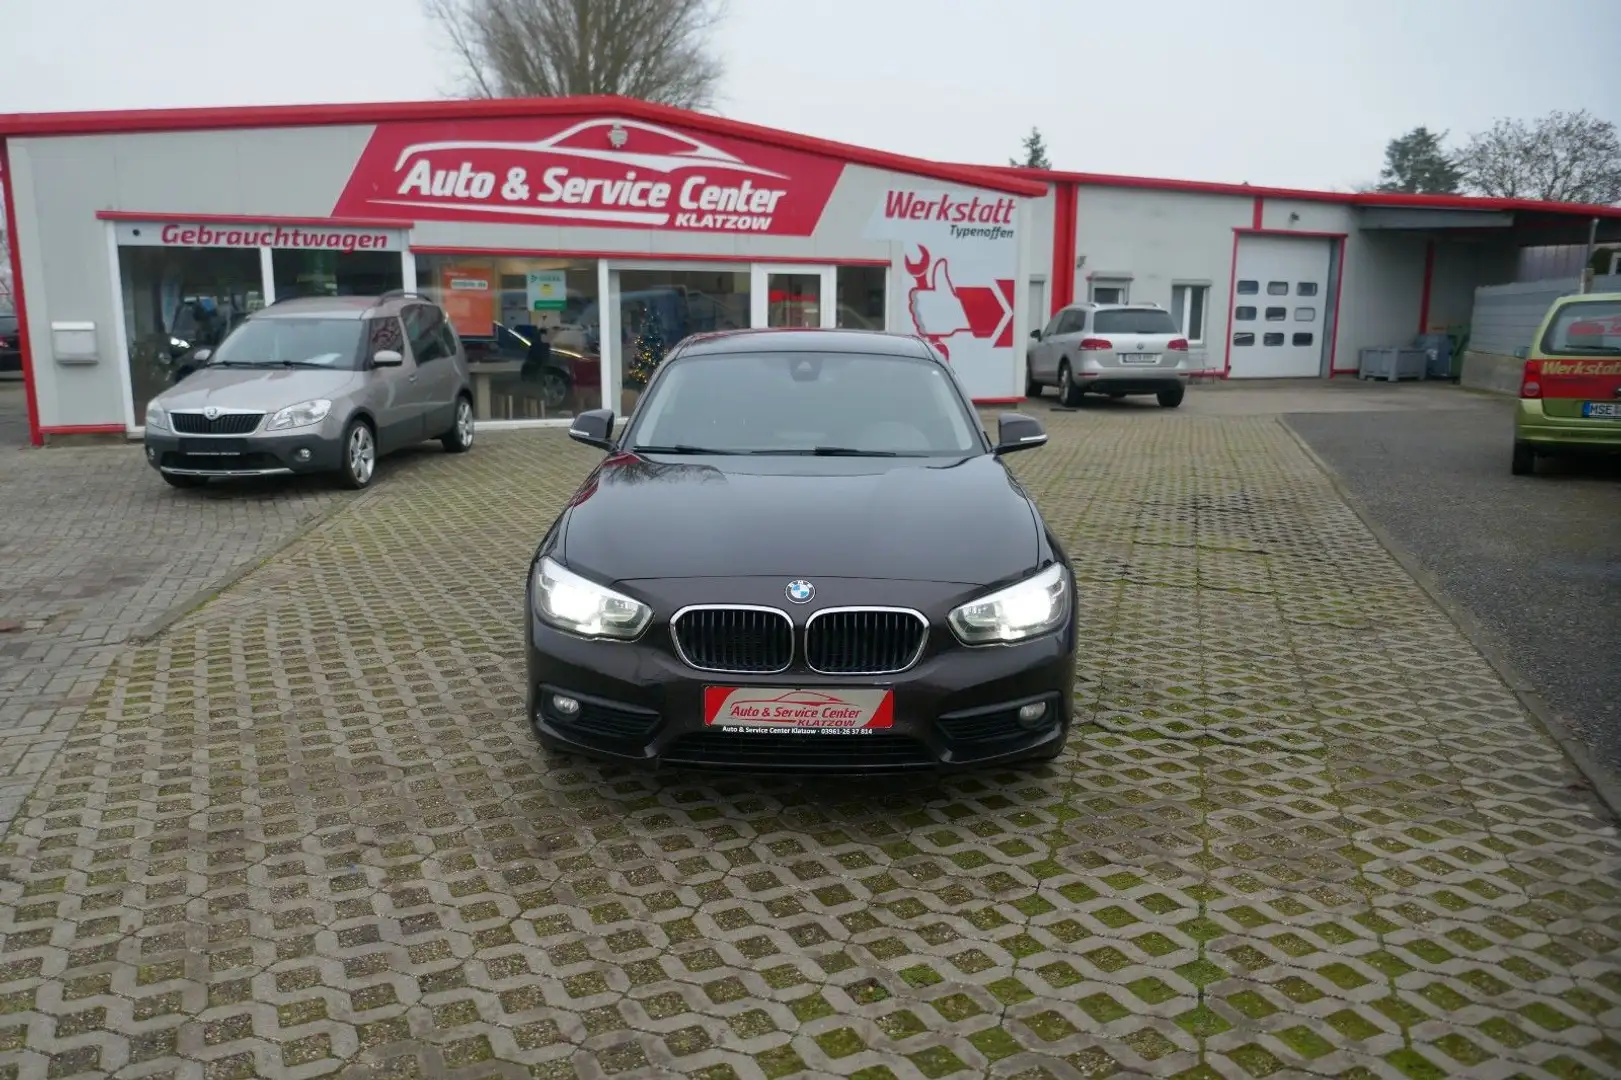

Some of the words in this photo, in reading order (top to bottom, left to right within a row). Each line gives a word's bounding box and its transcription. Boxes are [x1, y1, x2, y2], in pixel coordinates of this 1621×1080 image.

[397, 158, 496, 199] Auto
[501, 166, 530, 201] &
[537, 165, 671, 208] Service
[679, 175, 787, 213] Center
[885, 190, 1016, 224] Werkstatt
[675, 212, 772, 230] KLATZOW
[949, 224, 1014, 240] Typenoffen
[161, 224, 388, 255] Gebrauchtwagen
[731, 706, 759, 717] Auto
[761, 707, 770, 717] &
[774, 707, 818, 718] Service
[821, 707, 862, 719] Center
